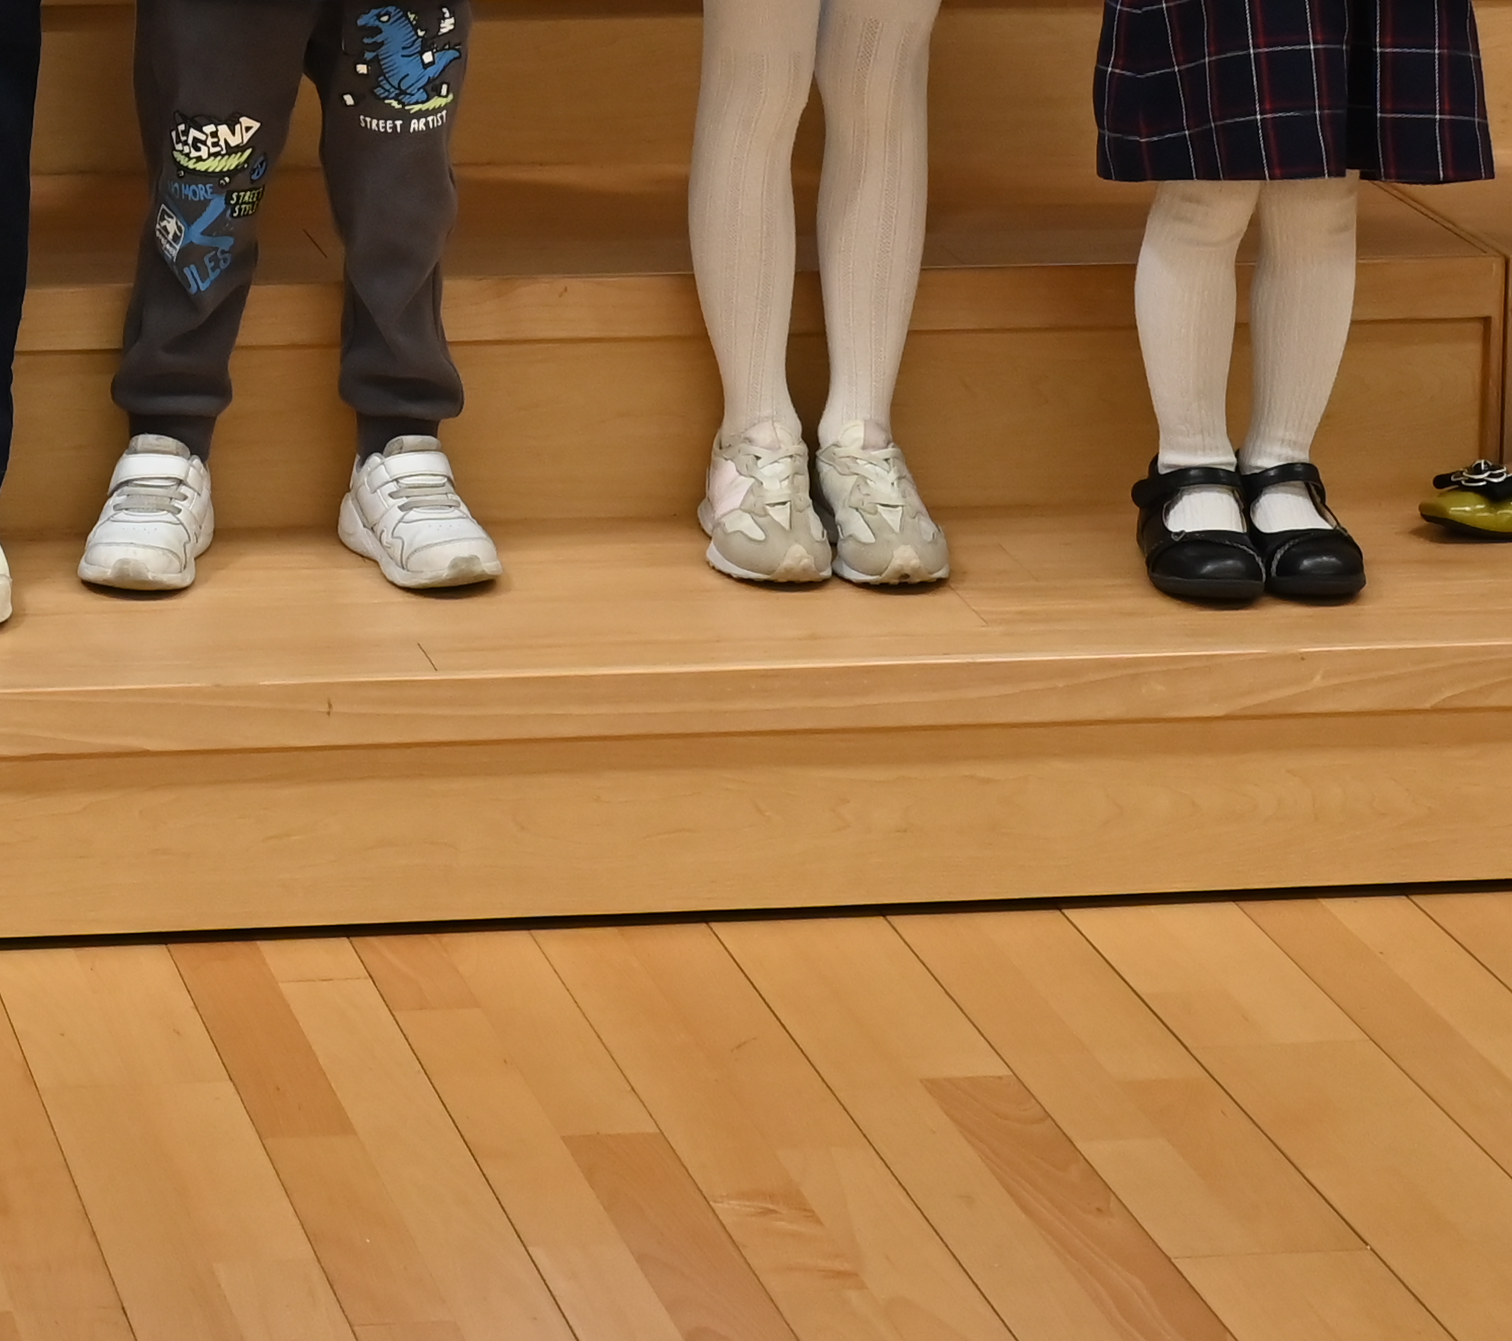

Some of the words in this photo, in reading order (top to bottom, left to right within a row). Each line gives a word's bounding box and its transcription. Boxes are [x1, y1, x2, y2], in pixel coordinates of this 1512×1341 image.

[359, 114, 403, 133] STREET
[409, 109, 448, 133] ARTIST
[171, 116, 262, 160] LEGEND
[181, 182, 214, 201] MORE
